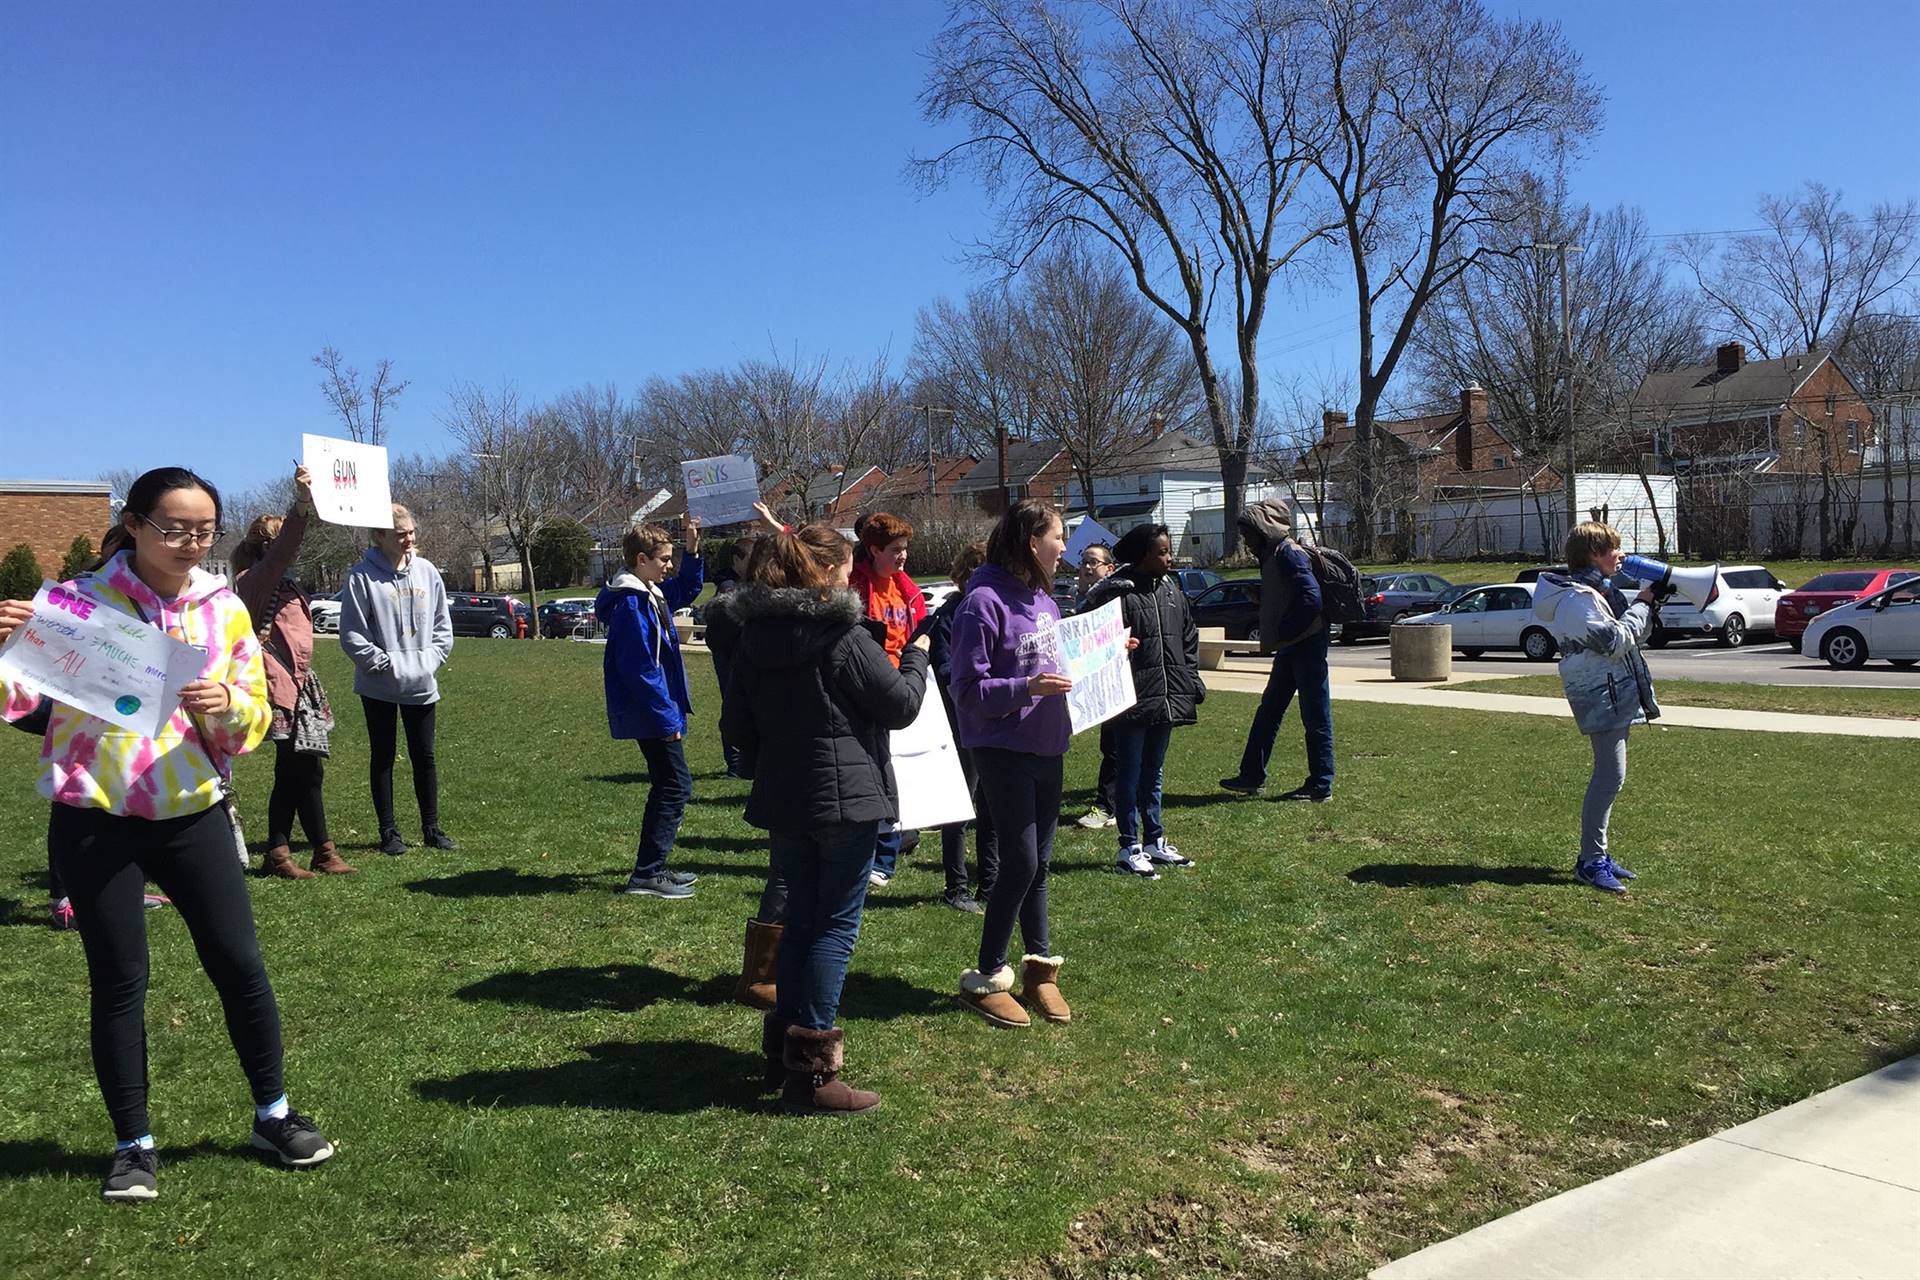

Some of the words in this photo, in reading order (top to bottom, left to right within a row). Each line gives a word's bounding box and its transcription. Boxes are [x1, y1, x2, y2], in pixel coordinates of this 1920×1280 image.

[333, 458, 357, 485] GUN
[47, 586, 98, 621] ONE
[1059, 620, 1090, 642] NRA
[23, 629, 46, 648] than
[54, 648, 88, 678] ALL
